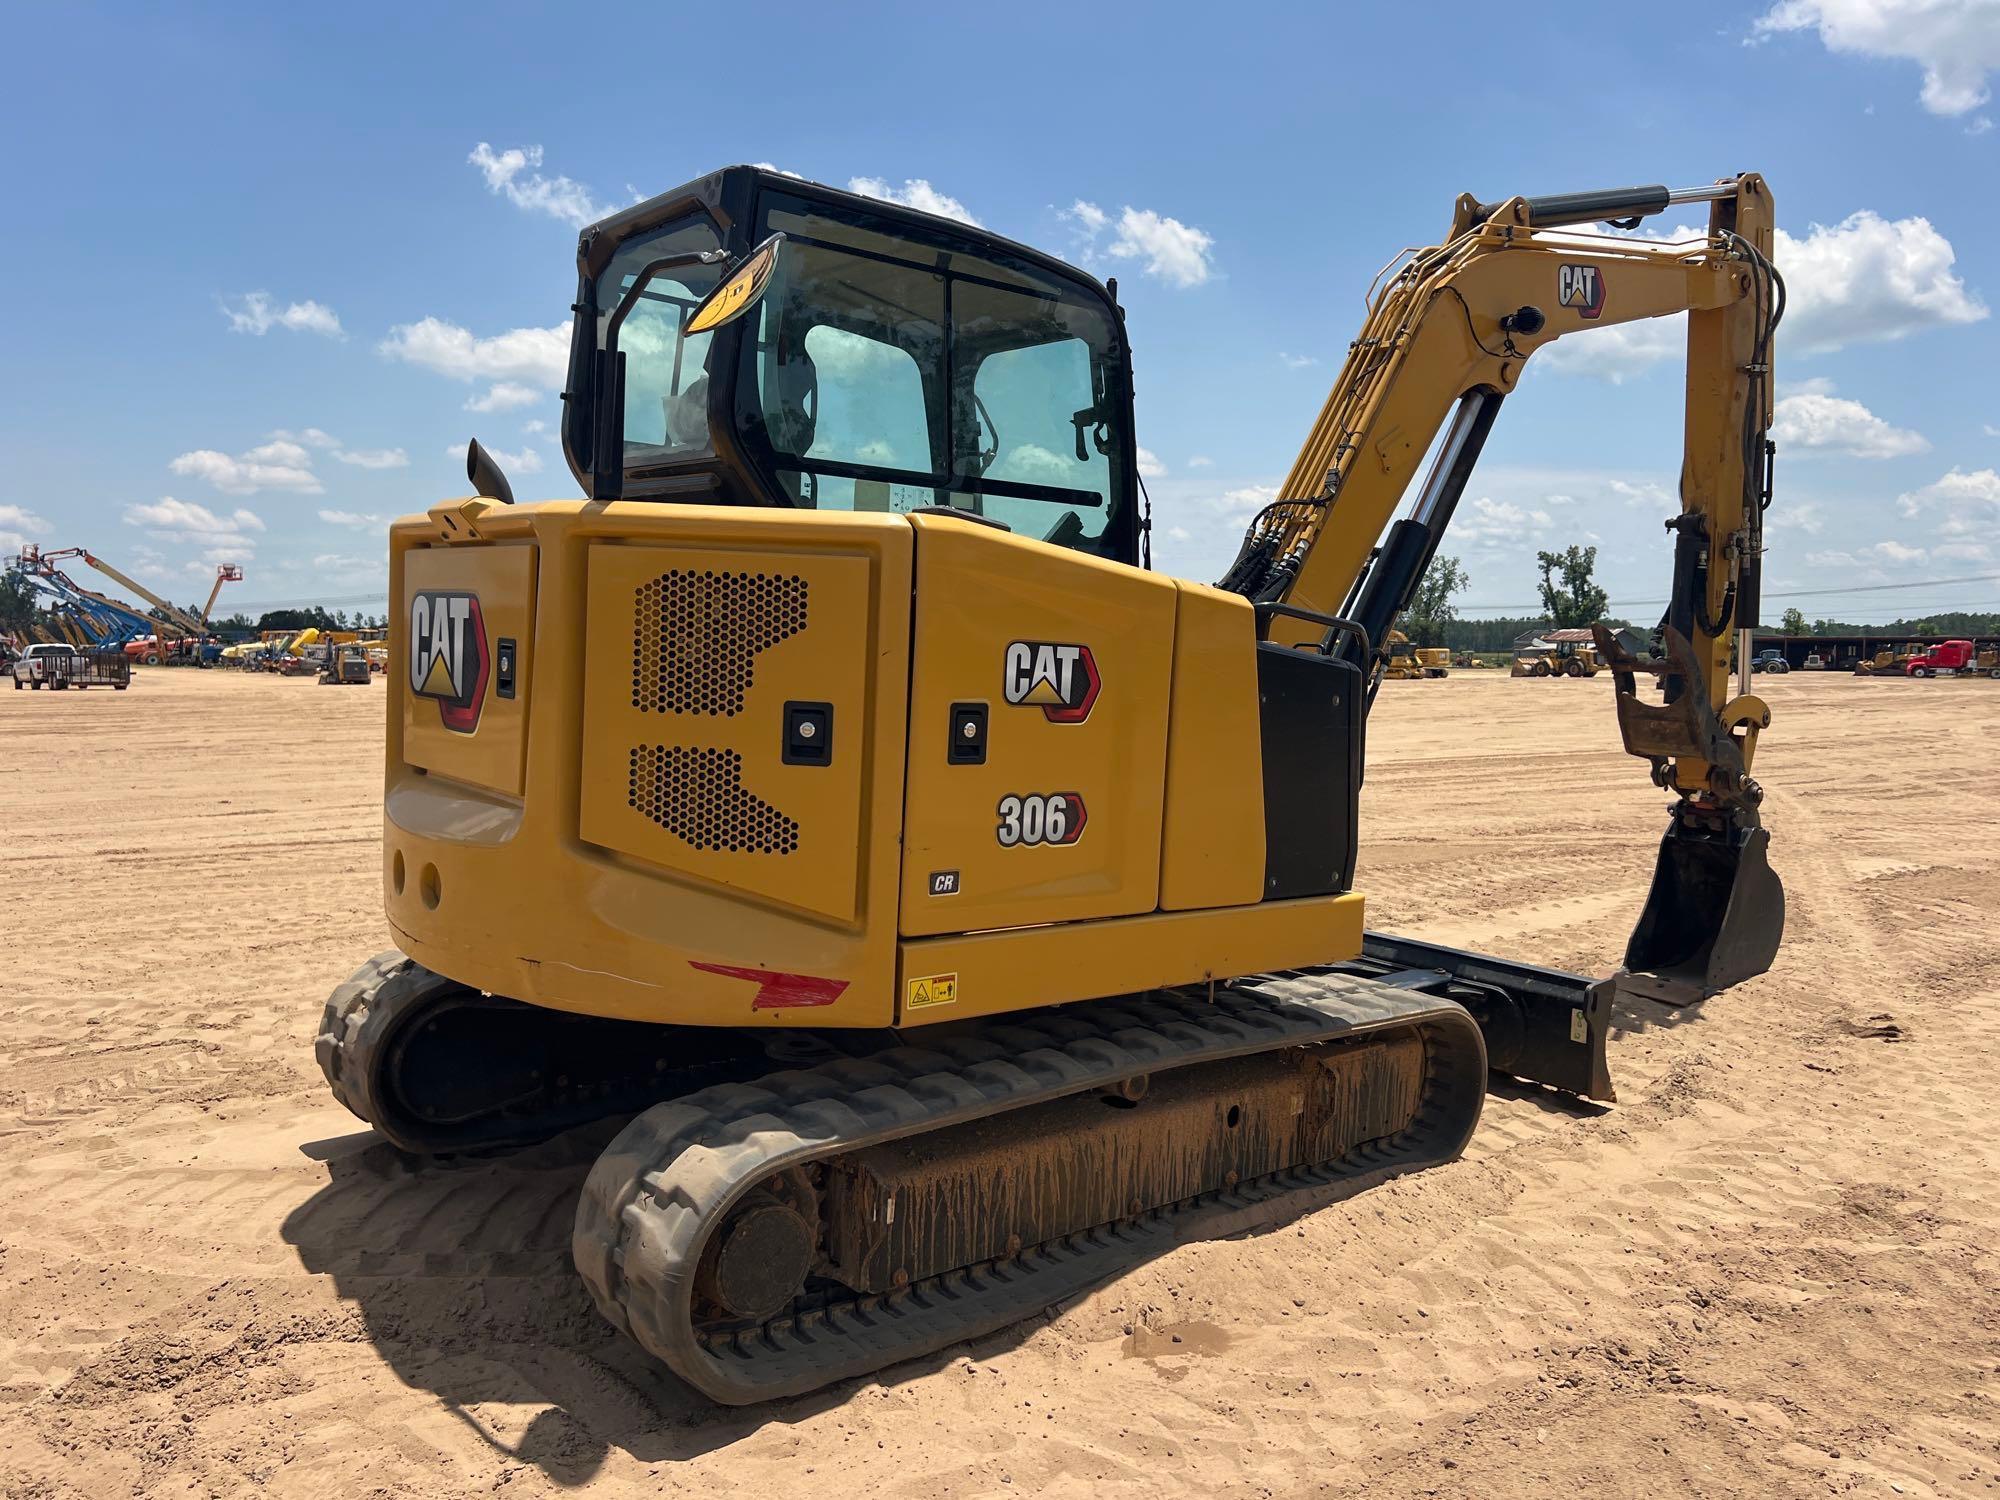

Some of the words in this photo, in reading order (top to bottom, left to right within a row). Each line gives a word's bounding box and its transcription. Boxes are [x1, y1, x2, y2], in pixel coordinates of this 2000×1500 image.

[1559, 265, 1595, 306] CAT
[411, 595, 470, 698] CAT
[1005, 642, 1080, 704] CAT
[999, 795, 1067, 844] 306
[934, 874, 954, 891] CR
